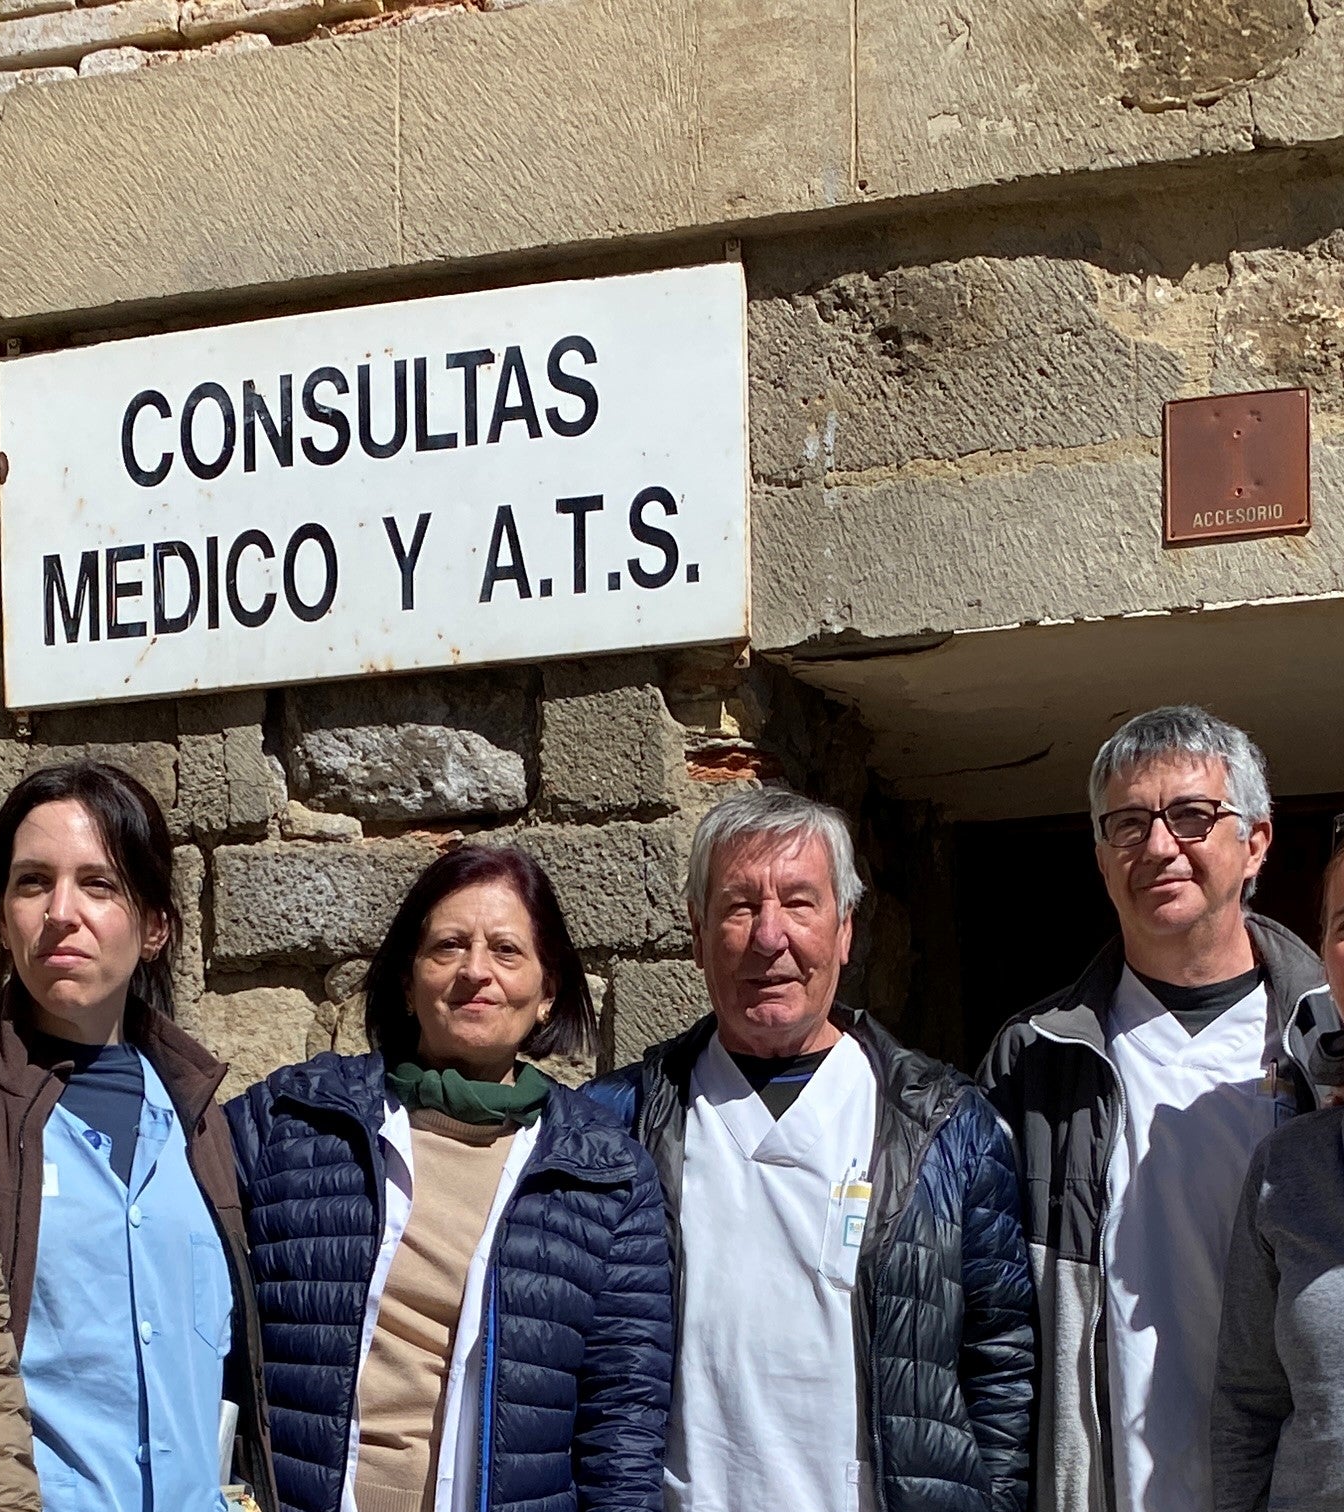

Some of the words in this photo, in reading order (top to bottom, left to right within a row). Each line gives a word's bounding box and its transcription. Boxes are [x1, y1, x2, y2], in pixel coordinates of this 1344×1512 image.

[121, 335, 599, 488] CONSULTAS
[43, 522, 338, 647] MEDICO
[382, 512, 432, 611] Y
[478, 486, 700, 603] A.T.S.
[1192, 503, 1284, 529] ACCESORIO
